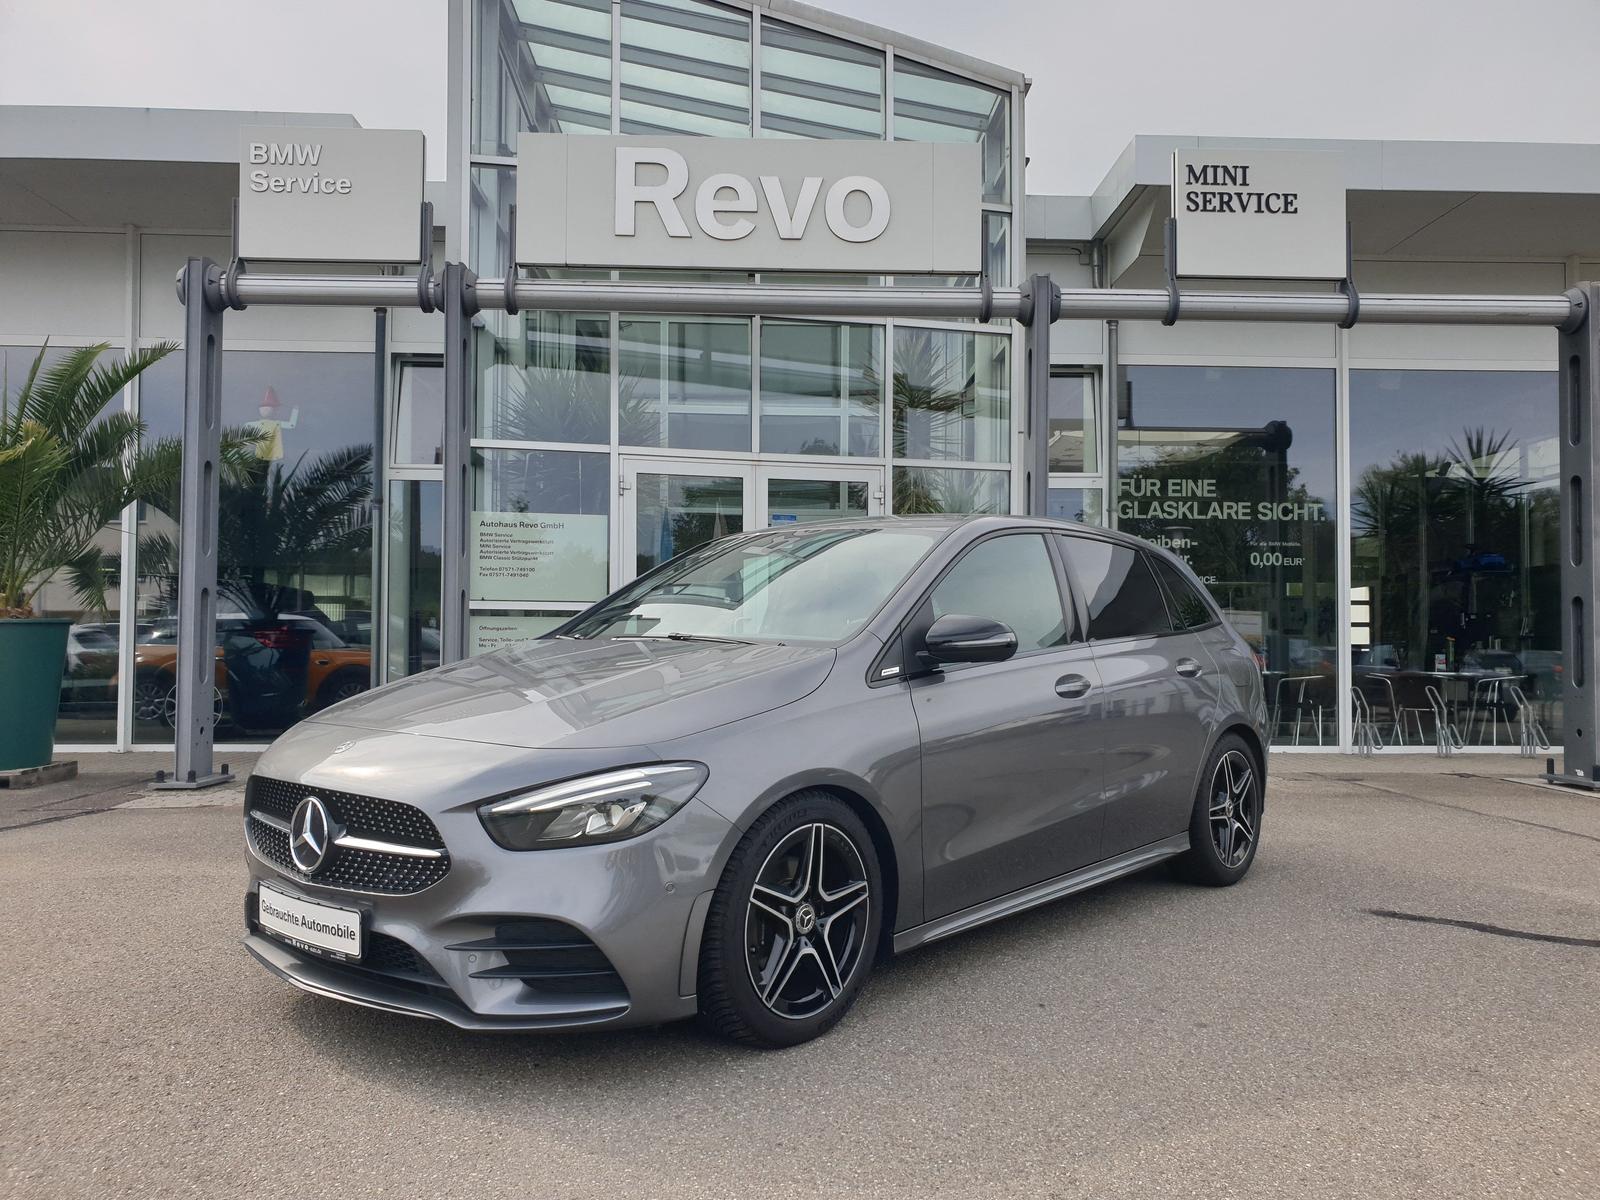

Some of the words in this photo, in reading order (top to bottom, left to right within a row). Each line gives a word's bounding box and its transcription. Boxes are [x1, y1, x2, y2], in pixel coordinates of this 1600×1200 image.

[249, 142, 322, 166] BMW
[249, 170, 352, 194] Service
[1185, 164, 1249, 187] MINI
[614, 147, 891, 243] Revo
[1185, 191, 1298, 214] SERVICE
[1117, 475, 1161, 497] FÜR
[1167, 479, 1217, 497] EINE
[1117, 501, 1251, 520] GLASKLARE
[1257, 503, 1326, 521] SICHT.
[479, 520, 518, 529] Autohaus
[519, 521, 539, 529] Revo
[1250, 552, 1282, 568] 0,00
[261, 899, 300, 926] Gebrauchte
[301, 914, 356, 941] Automobile
